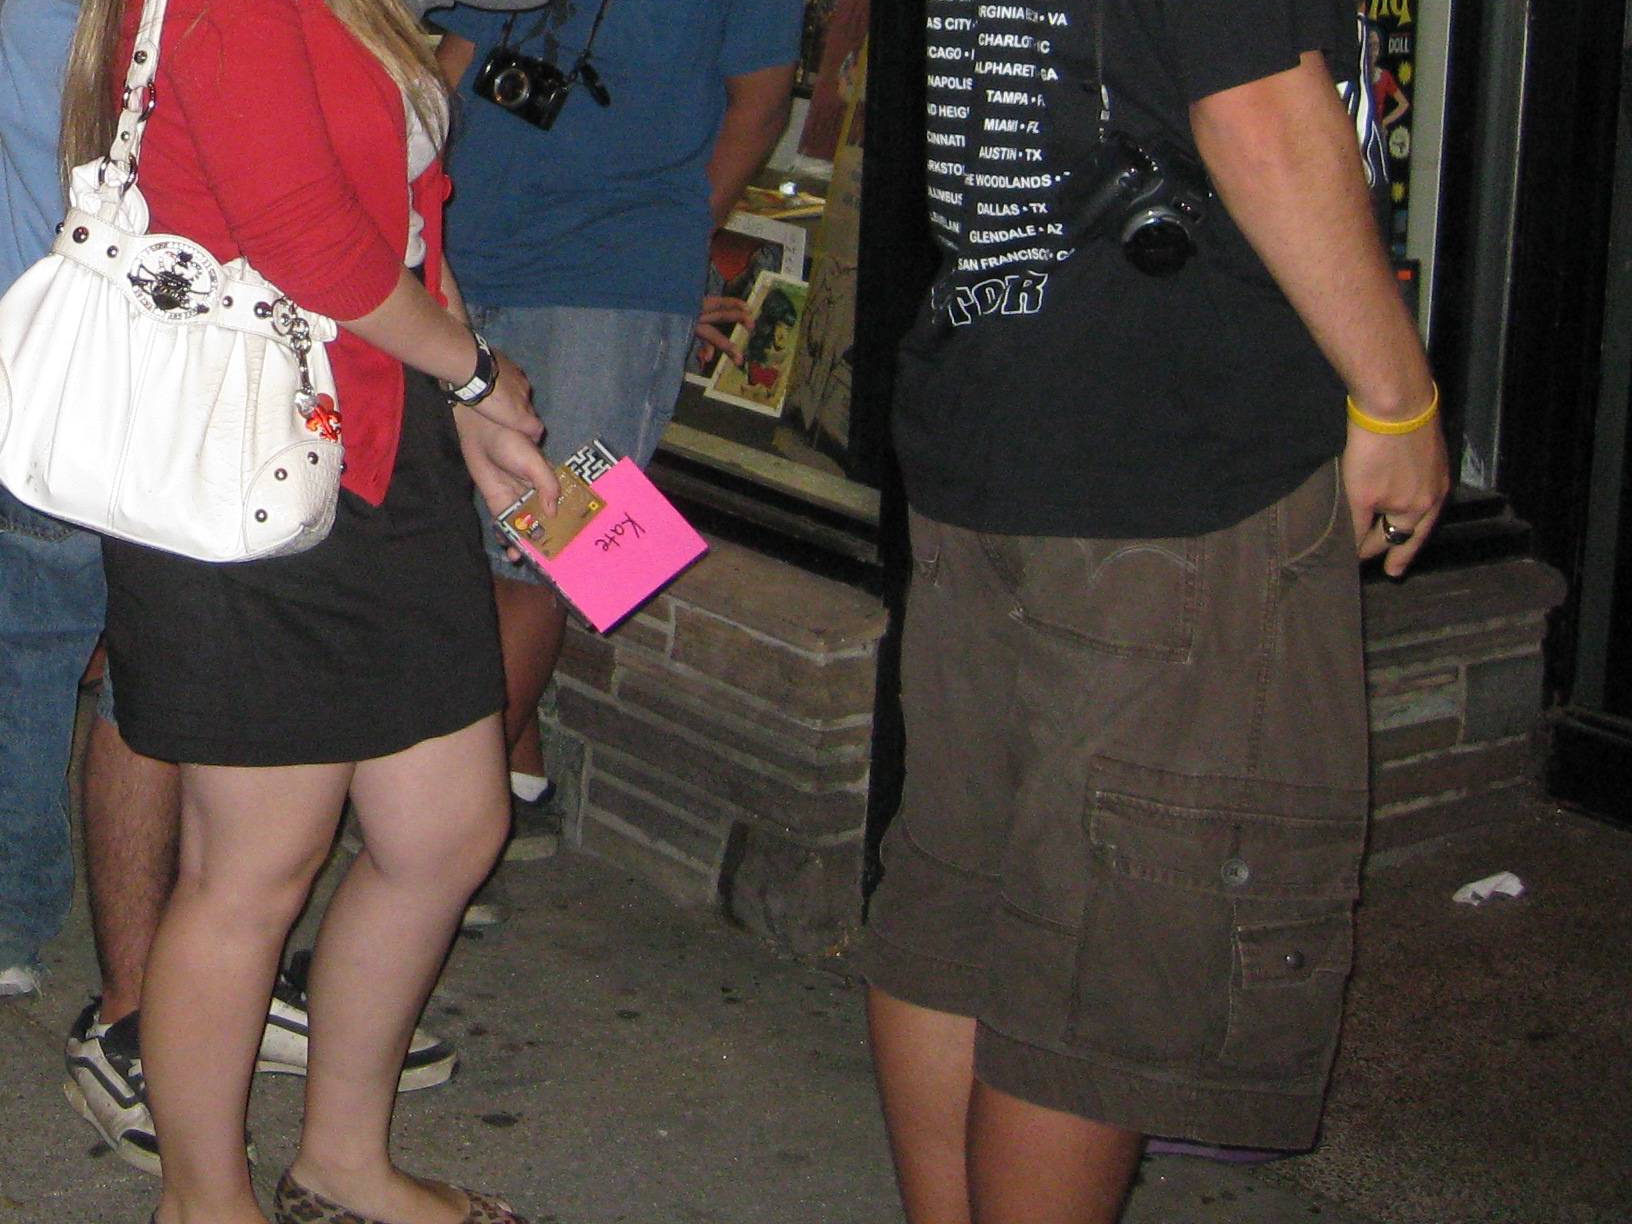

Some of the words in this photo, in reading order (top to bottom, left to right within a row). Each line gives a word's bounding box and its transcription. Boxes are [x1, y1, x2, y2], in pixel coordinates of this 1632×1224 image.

[1048, 12, 1068, 26] VA
[986, 90, 1029, 106] TAMPA
[979, 146, 1017, 161] AUSTIN
[1024, 148, 1043, 161] TX
[976, 174, 1052, 189] WOODLANDS
[977, 202, 1020, 217] DALLAS
[1029, 202, 1048, 214] TX
[969, 224, 1037, 244] GLENDALE
[1047, 223, 1063, 235] AZ
[957, 257, 979, 271] SAN
[594, 511, 646, 552] Kate
